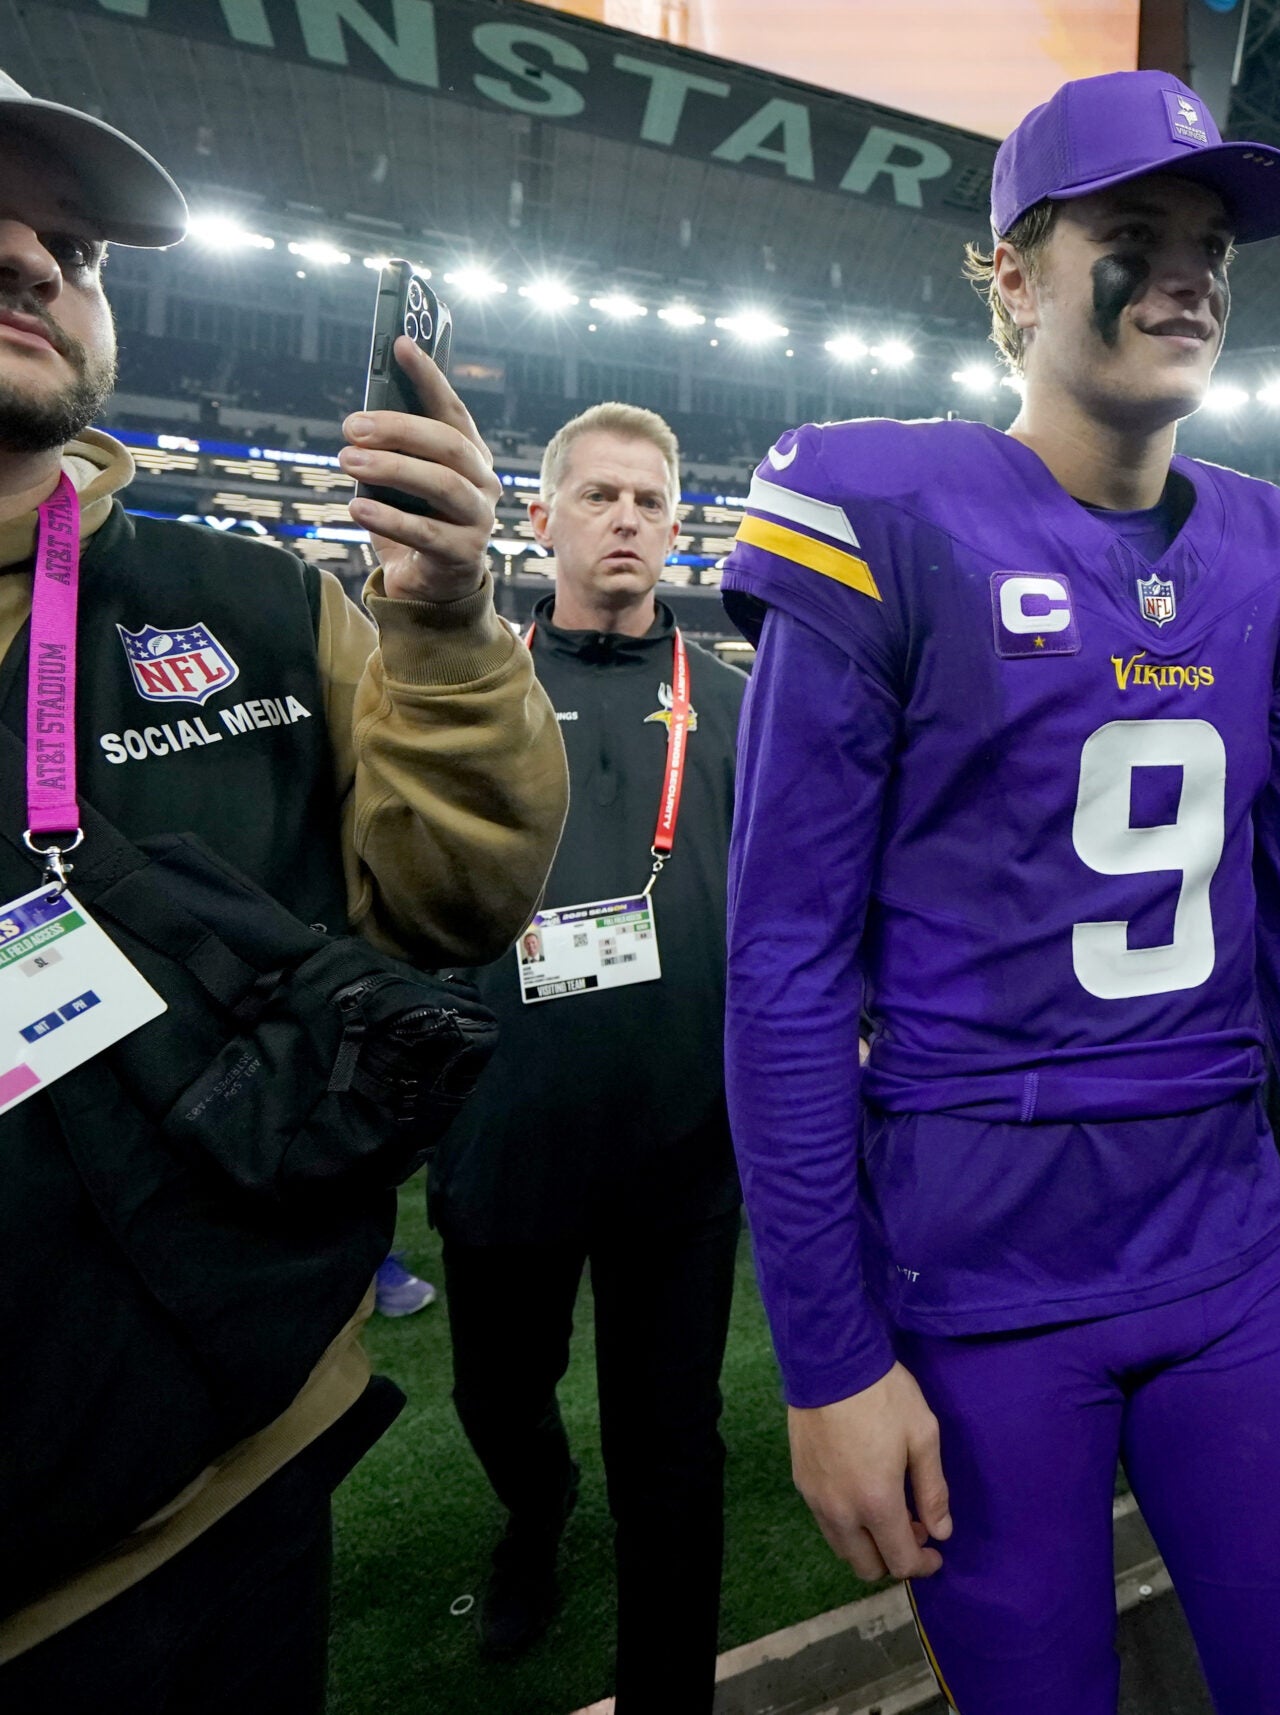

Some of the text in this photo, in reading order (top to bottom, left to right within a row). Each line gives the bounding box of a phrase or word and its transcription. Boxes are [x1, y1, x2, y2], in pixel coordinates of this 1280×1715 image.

[1000, 577, 1071, 634] C
[1145, 597, 1171, 616] NFL
[135, 647, 226, 694] NFL
[37, 642, 67, 790] AT&T STADIUM
[100, 695, 312, 765] SOCIAL MEDIA
[663, 769, 679, 829] SECURITY
[1072, 719, 1226, 1000] 9
[567, 978, 586, 991] TEAM
